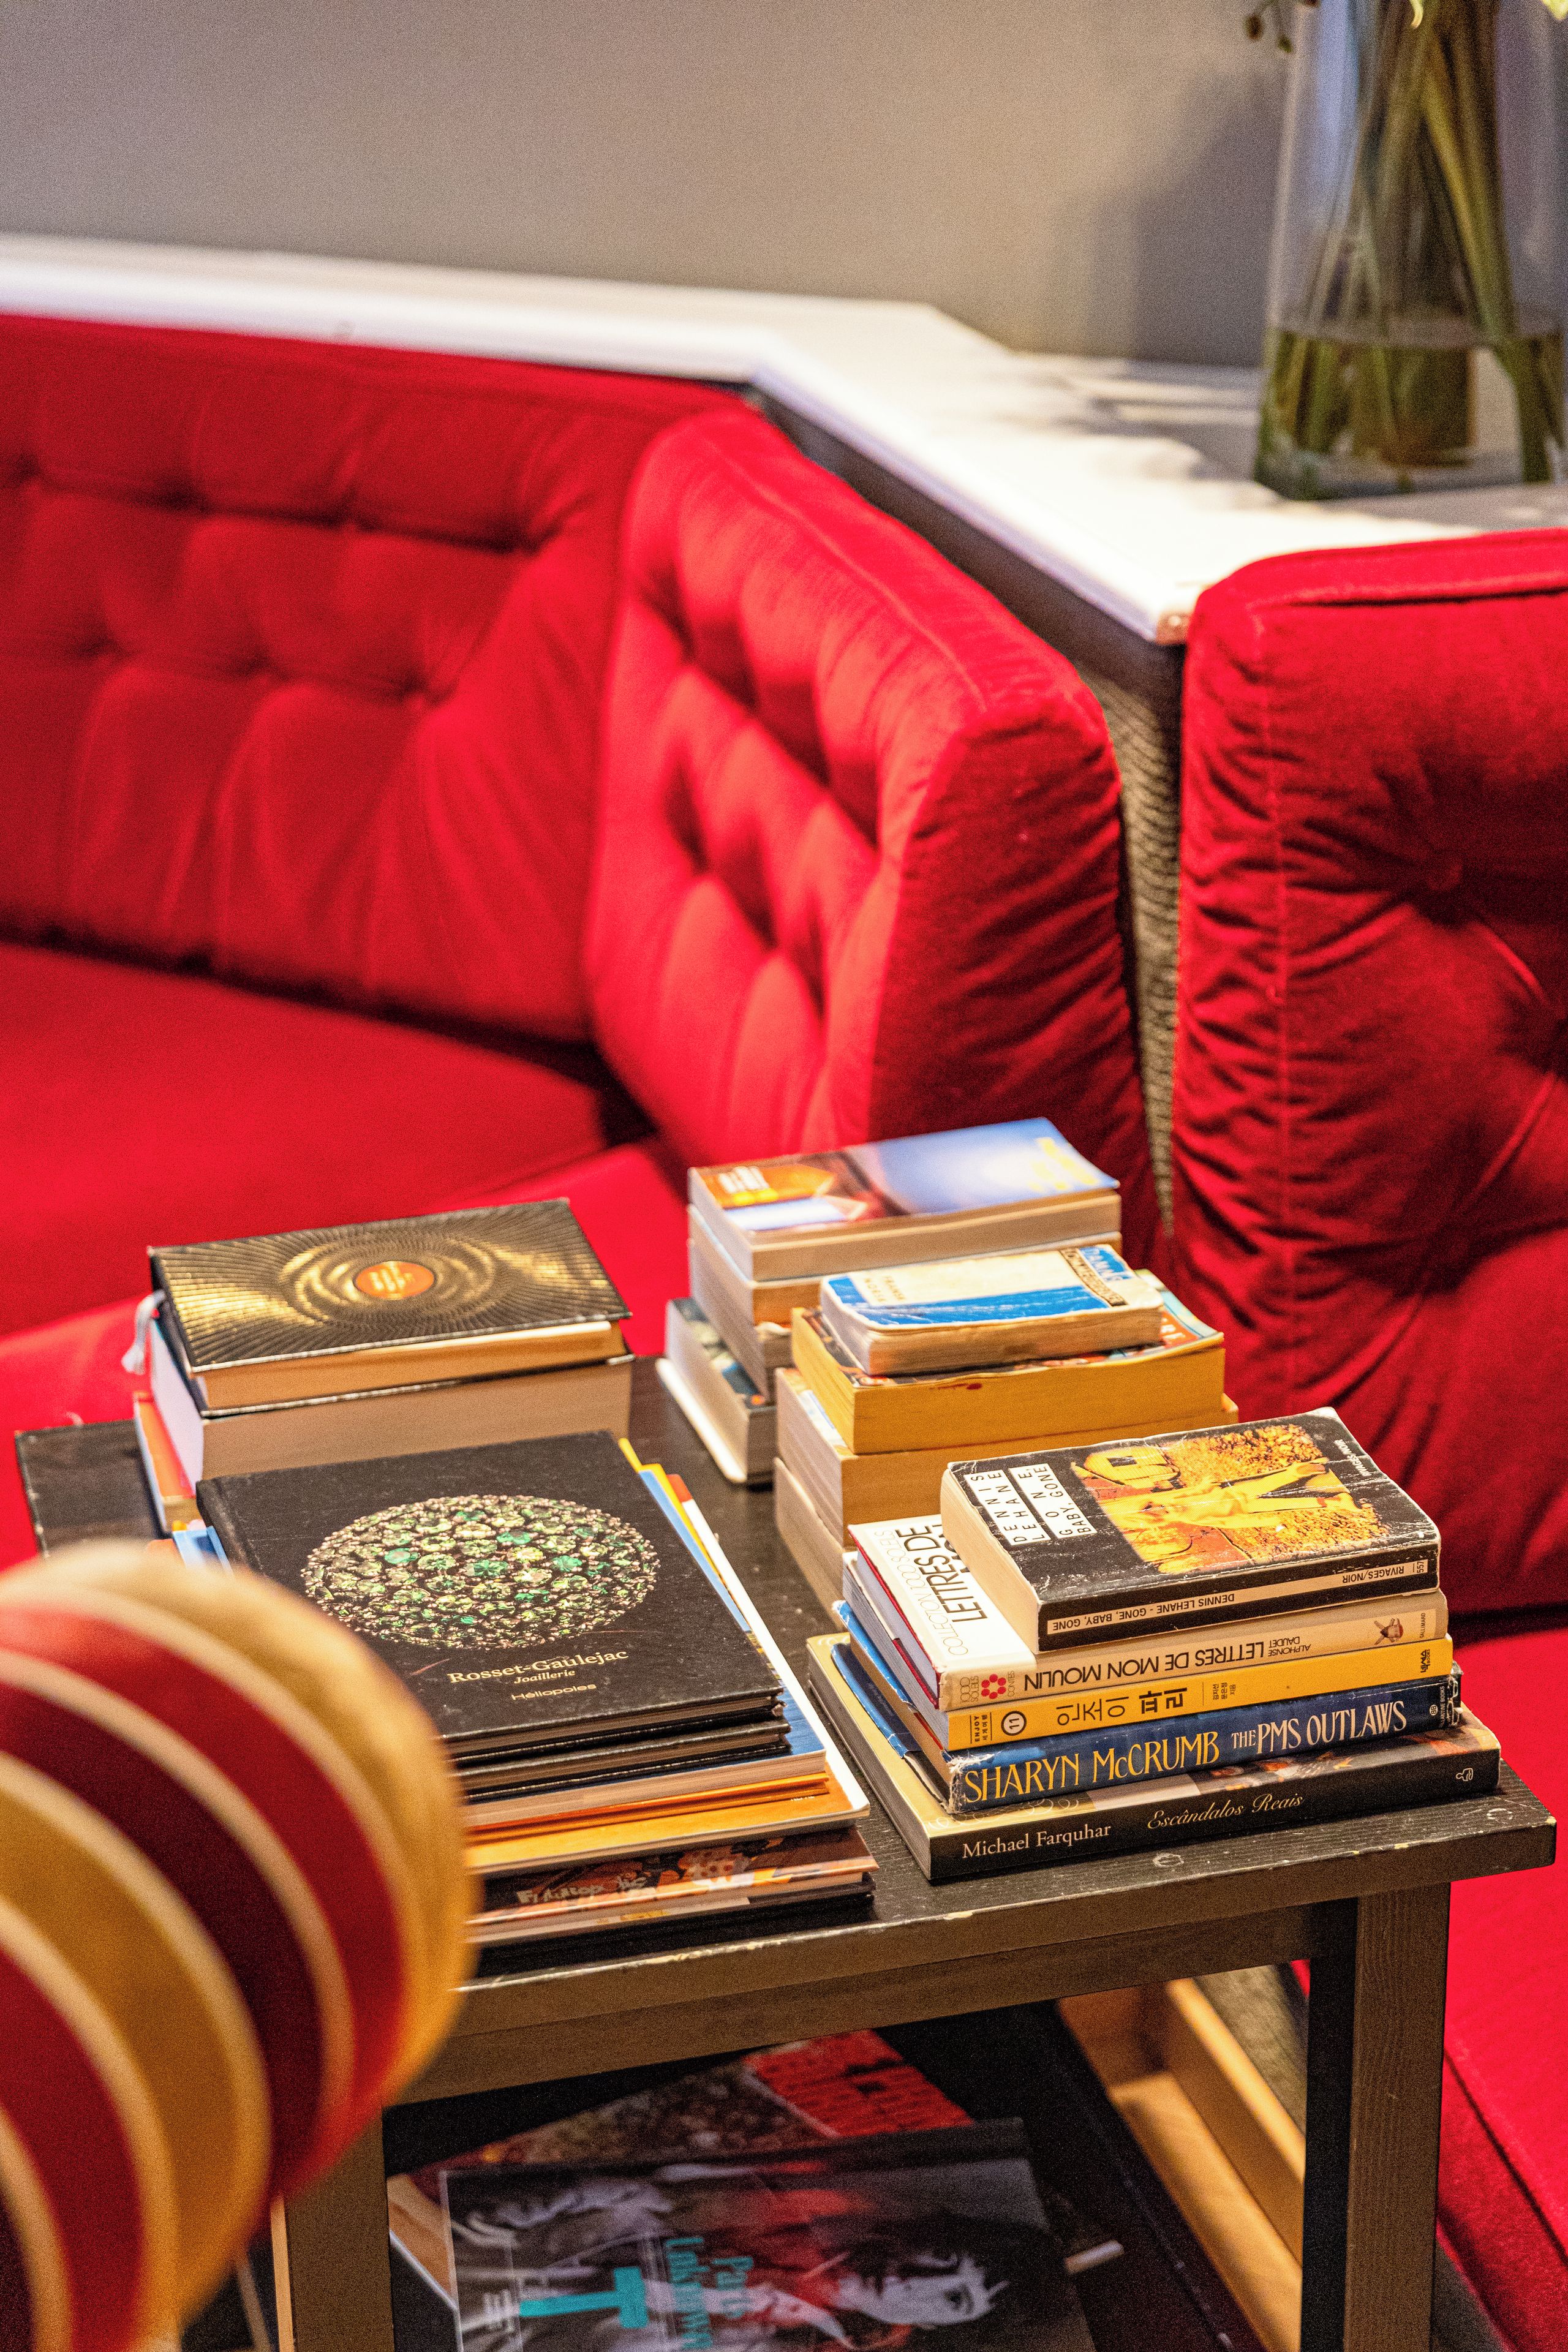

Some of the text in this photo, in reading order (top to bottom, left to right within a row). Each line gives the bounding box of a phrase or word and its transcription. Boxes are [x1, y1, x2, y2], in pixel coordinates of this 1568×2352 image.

[1333, 1439, 1372, 1477] RIVAGES/NOIR
[970, 1474, 1027, 1543] DENNIS
[987, 1471, 1045, 1540] LEHANE
[1033, 1466, 1092, 1534] BABY, GONE
[873, 1529, 910, 1563] SOLEILS
[895, 1523, 941, 1551] DE
[897, 1564, 925, 1591] 1000
[914, 1555, 988, 1623] LETTRES
[1342, 1566, 1404, 1583] RIVAGES/NOIR
[1115, 1607, 1147, 1620] GONE,
[1156, 1600, 1196, 1614] LEHANE
[1198, 1593, 1235, 1607] DENNIS
[914, 1592, 968, 1656] COLLECTION
[1053, 1619, 1080, 1631] GONE
[1084, 1613, 1112, 1626] BABY,
[1268, 1636, 1300, 1648] DAUDET
[1268, 1644, 1311, 1657] ALPHONSE
[447, 1651, 628, 1683] Rosset-Gaulejac
[514, 1670, 576, 1684] Joaillerie
[1024, 1642, 1264, 1691] LETTRES DE MON MOULIN
[1139, 1687, 1188, 1714] 파리
[1009, 1717, 1020, 1730] 11
[1232, 1701, 1408, 1754] THE PMS OUTLAWS
[964, 1731, 1220, 1804] SHARYN McCRUMB
[1147, 1793, 1303, 1830] Escândalos Reais
[962, 1823, 1112, 1859] Michael Farquhar
